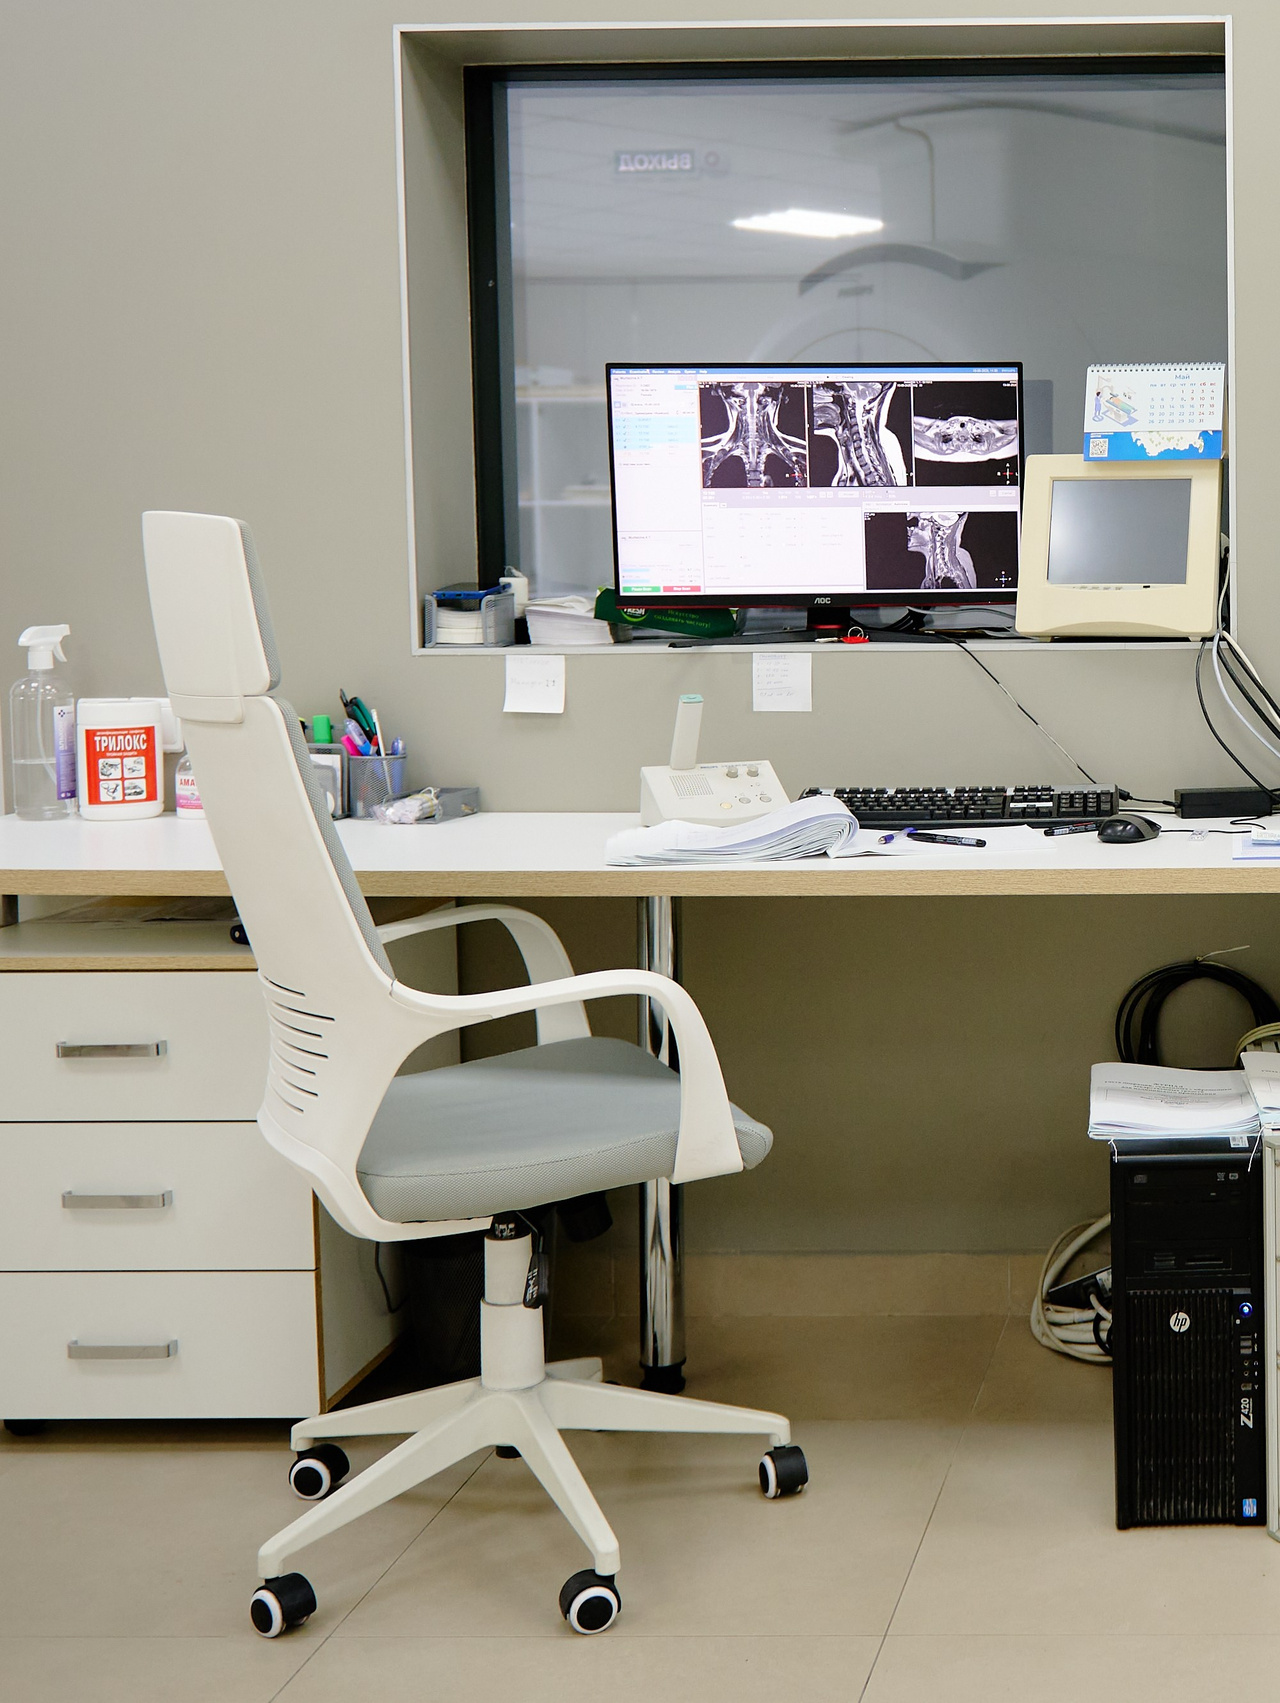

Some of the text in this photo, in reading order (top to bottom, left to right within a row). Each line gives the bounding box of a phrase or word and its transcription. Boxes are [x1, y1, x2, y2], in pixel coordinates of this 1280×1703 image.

[94, 734, 147, 752] ТРИЛОКС
[1172, 1311, 1188, 1332] hp
[1240, 1398, 1253, 1429] Z420
